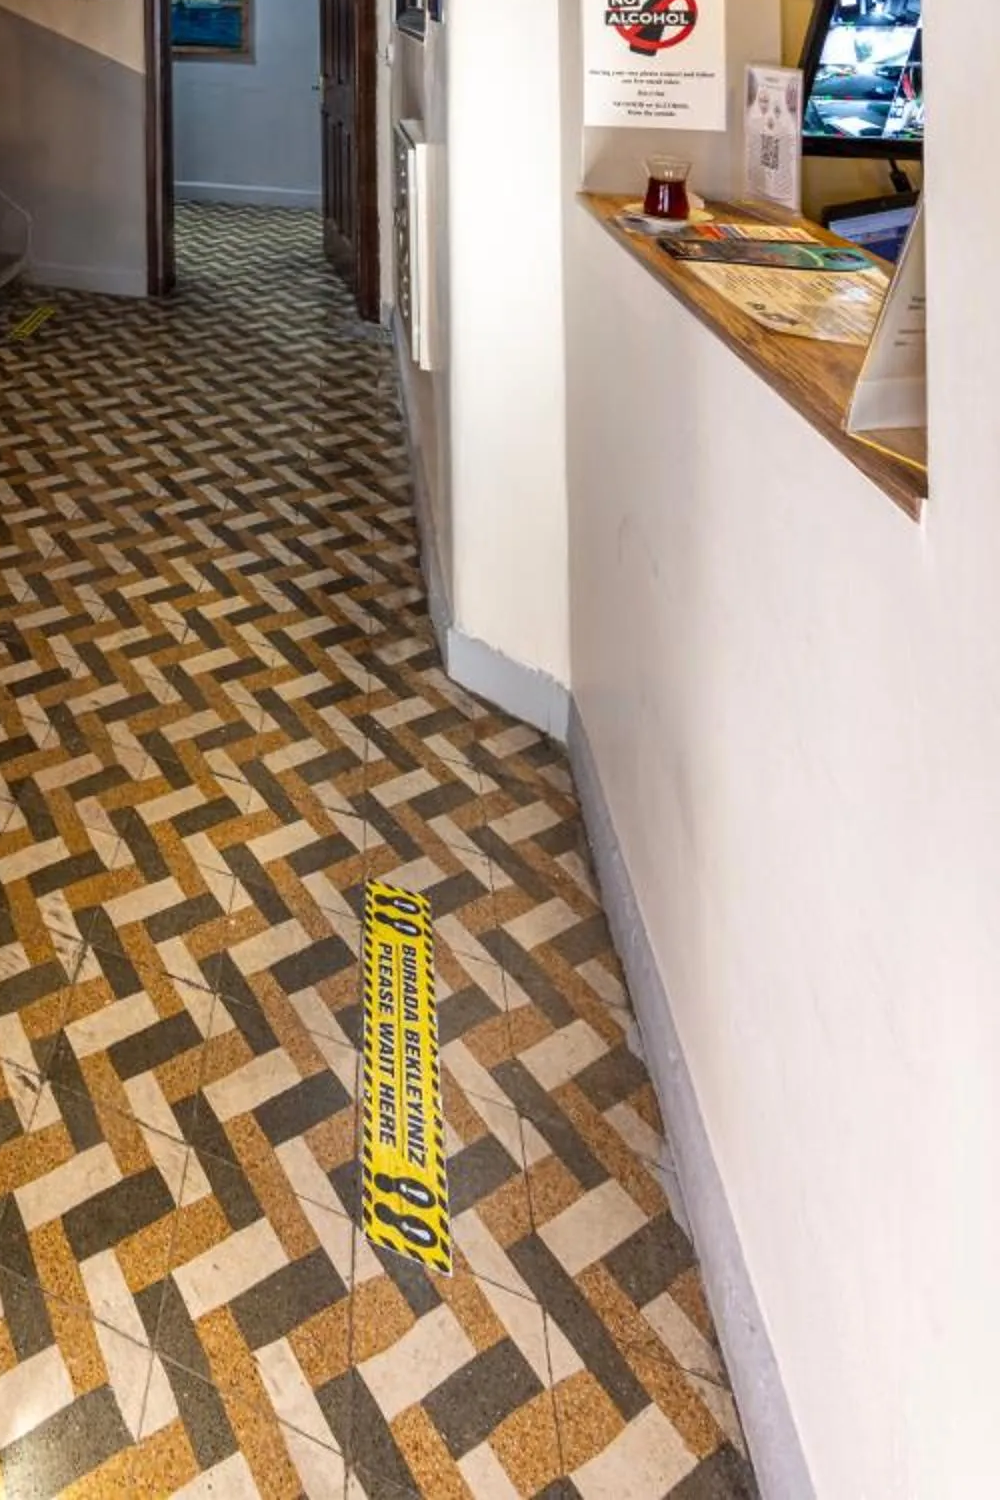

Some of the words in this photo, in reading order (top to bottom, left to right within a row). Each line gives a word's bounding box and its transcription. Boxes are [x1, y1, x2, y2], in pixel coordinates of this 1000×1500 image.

[607, 11, 690, 25] ALCOHOL
[378, 942, 394, 1016] PLEASE
[402, 943, 419, 1022] BURADA
[378, 1022, 395, 1079] WAIT
[378, 1081, 397, 1149] HERE
